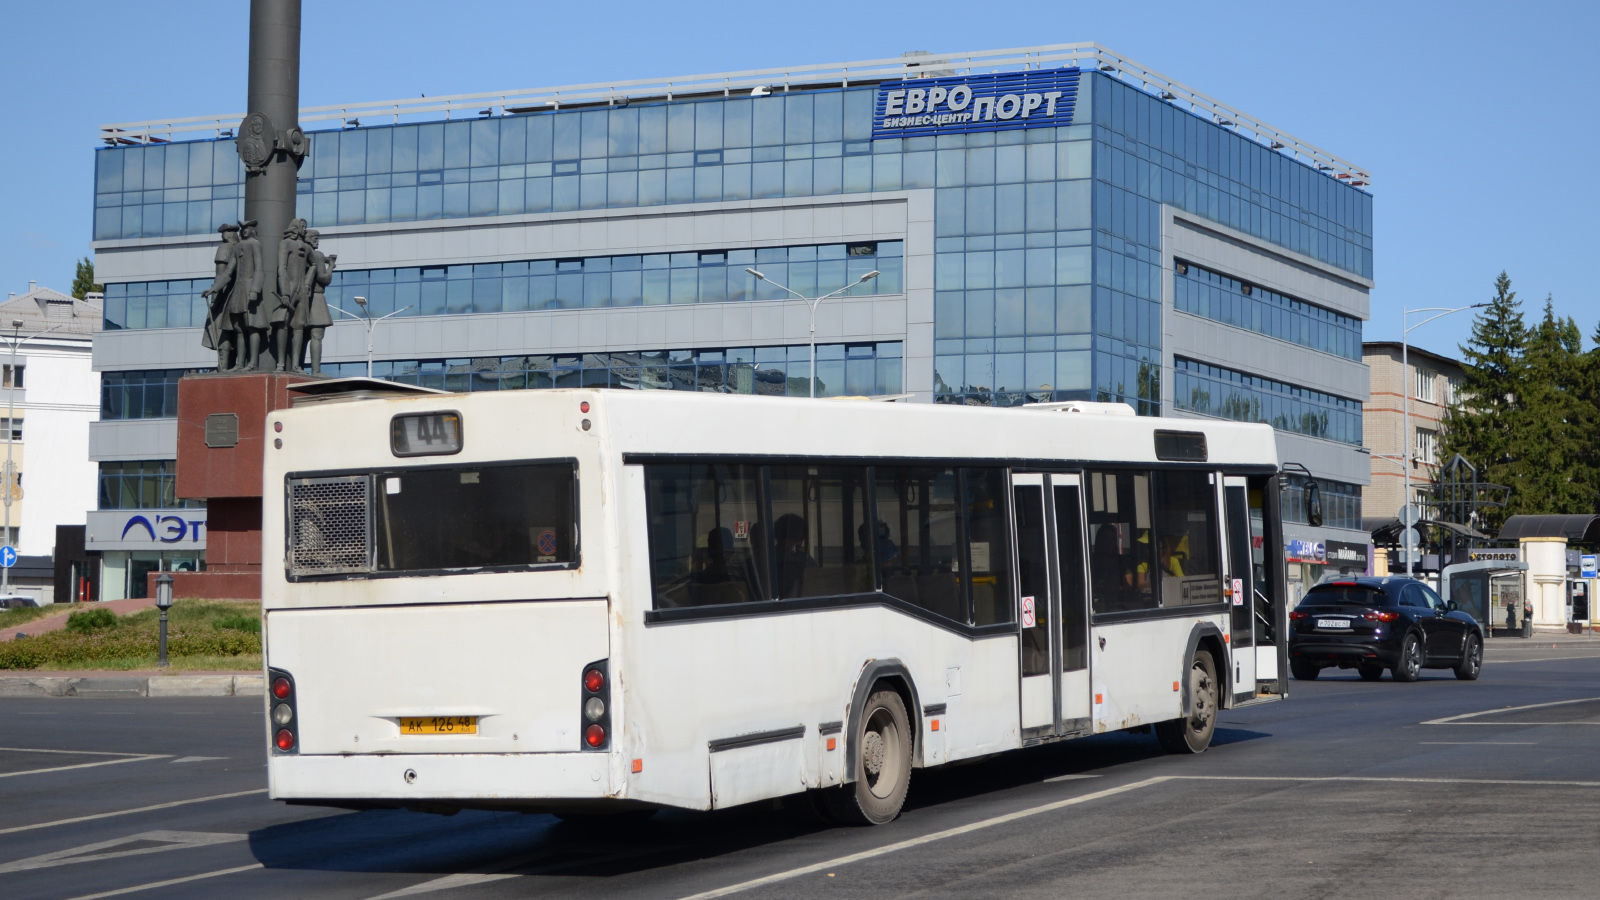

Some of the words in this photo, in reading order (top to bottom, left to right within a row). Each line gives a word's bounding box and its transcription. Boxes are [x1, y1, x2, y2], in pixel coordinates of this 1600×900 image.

[885, 85, 972, 116] ЕВРО
[972, 91, 1062, 121] ПОРТ
[883, 112, 972, 128] БИЗНЕС-ЦЕНТР
[417, 416, 448, 445] 44
[121, 515, 207, 543] Л'ЭТ
[431, 717, 454, 732] 126
[458, 716, 471, 727] 48
